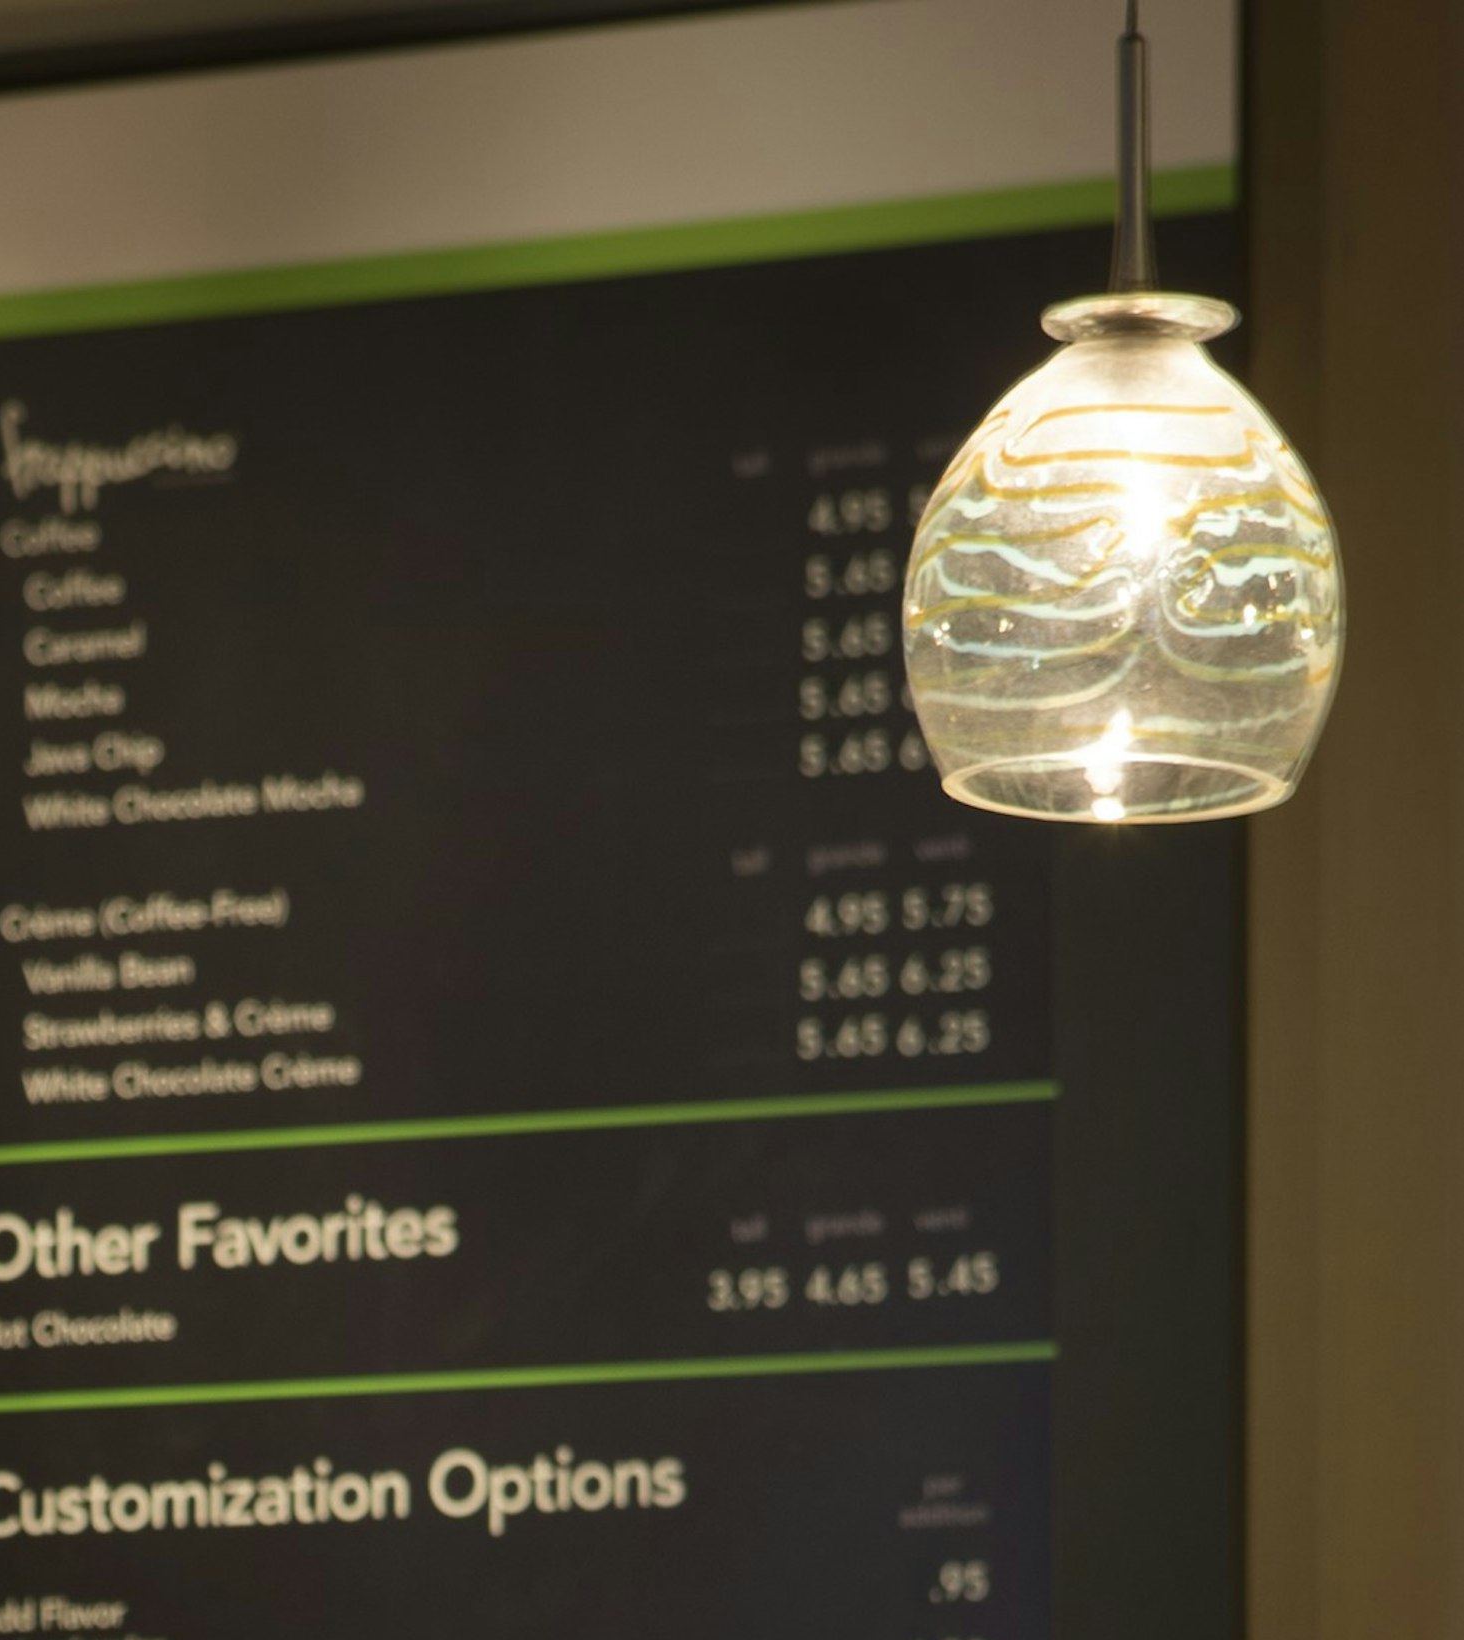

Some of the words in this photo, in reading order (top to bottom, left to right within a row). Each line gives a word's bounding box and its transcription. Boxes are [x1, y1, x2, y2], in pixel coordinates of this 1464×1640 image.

[24, 570, 126, 611] Coffee
[806, 549, 896, 598] 5.65
[24, 618, 146, 666] Caramel
[25, 679, 124, 720] Mocha
[23, 791, 110, 830] White
[113, 780, 259, 823] Chocolate
[262, 771, 364, 812] Mocha
[806, 891, 888, 936] 4.95
[902, 883, 993, 931] 5.75
[119, 951, 196, 988] Bean
[800, 954, 889, 1001] 5.65
[901, 946, 991, 994] 6.25
[24, 1006, 200, 1049] Strawberries
[205, 1001, 231, 1039] &
[798, 1013, 887, 1060] 5.65
[898, 1010, 990, 1057] 6.25
[22, 1065, 110, 1104] White
[113, 1056, 259, 1099] Chocolate
[178, 1195, 457, 1269] Favorites
[709, 1268, 789, 1310] 3.95
[805, 1262, 888, 1305] 4.65
[908, 1251, 998, 1299] 5.45
[32, 1307, 176, 1346] Chocolate
[429, 1445, 686, 1536] Options
[930, 1561, 989, 1602] .95
[40, 1596, 127, 1629] Flavor
